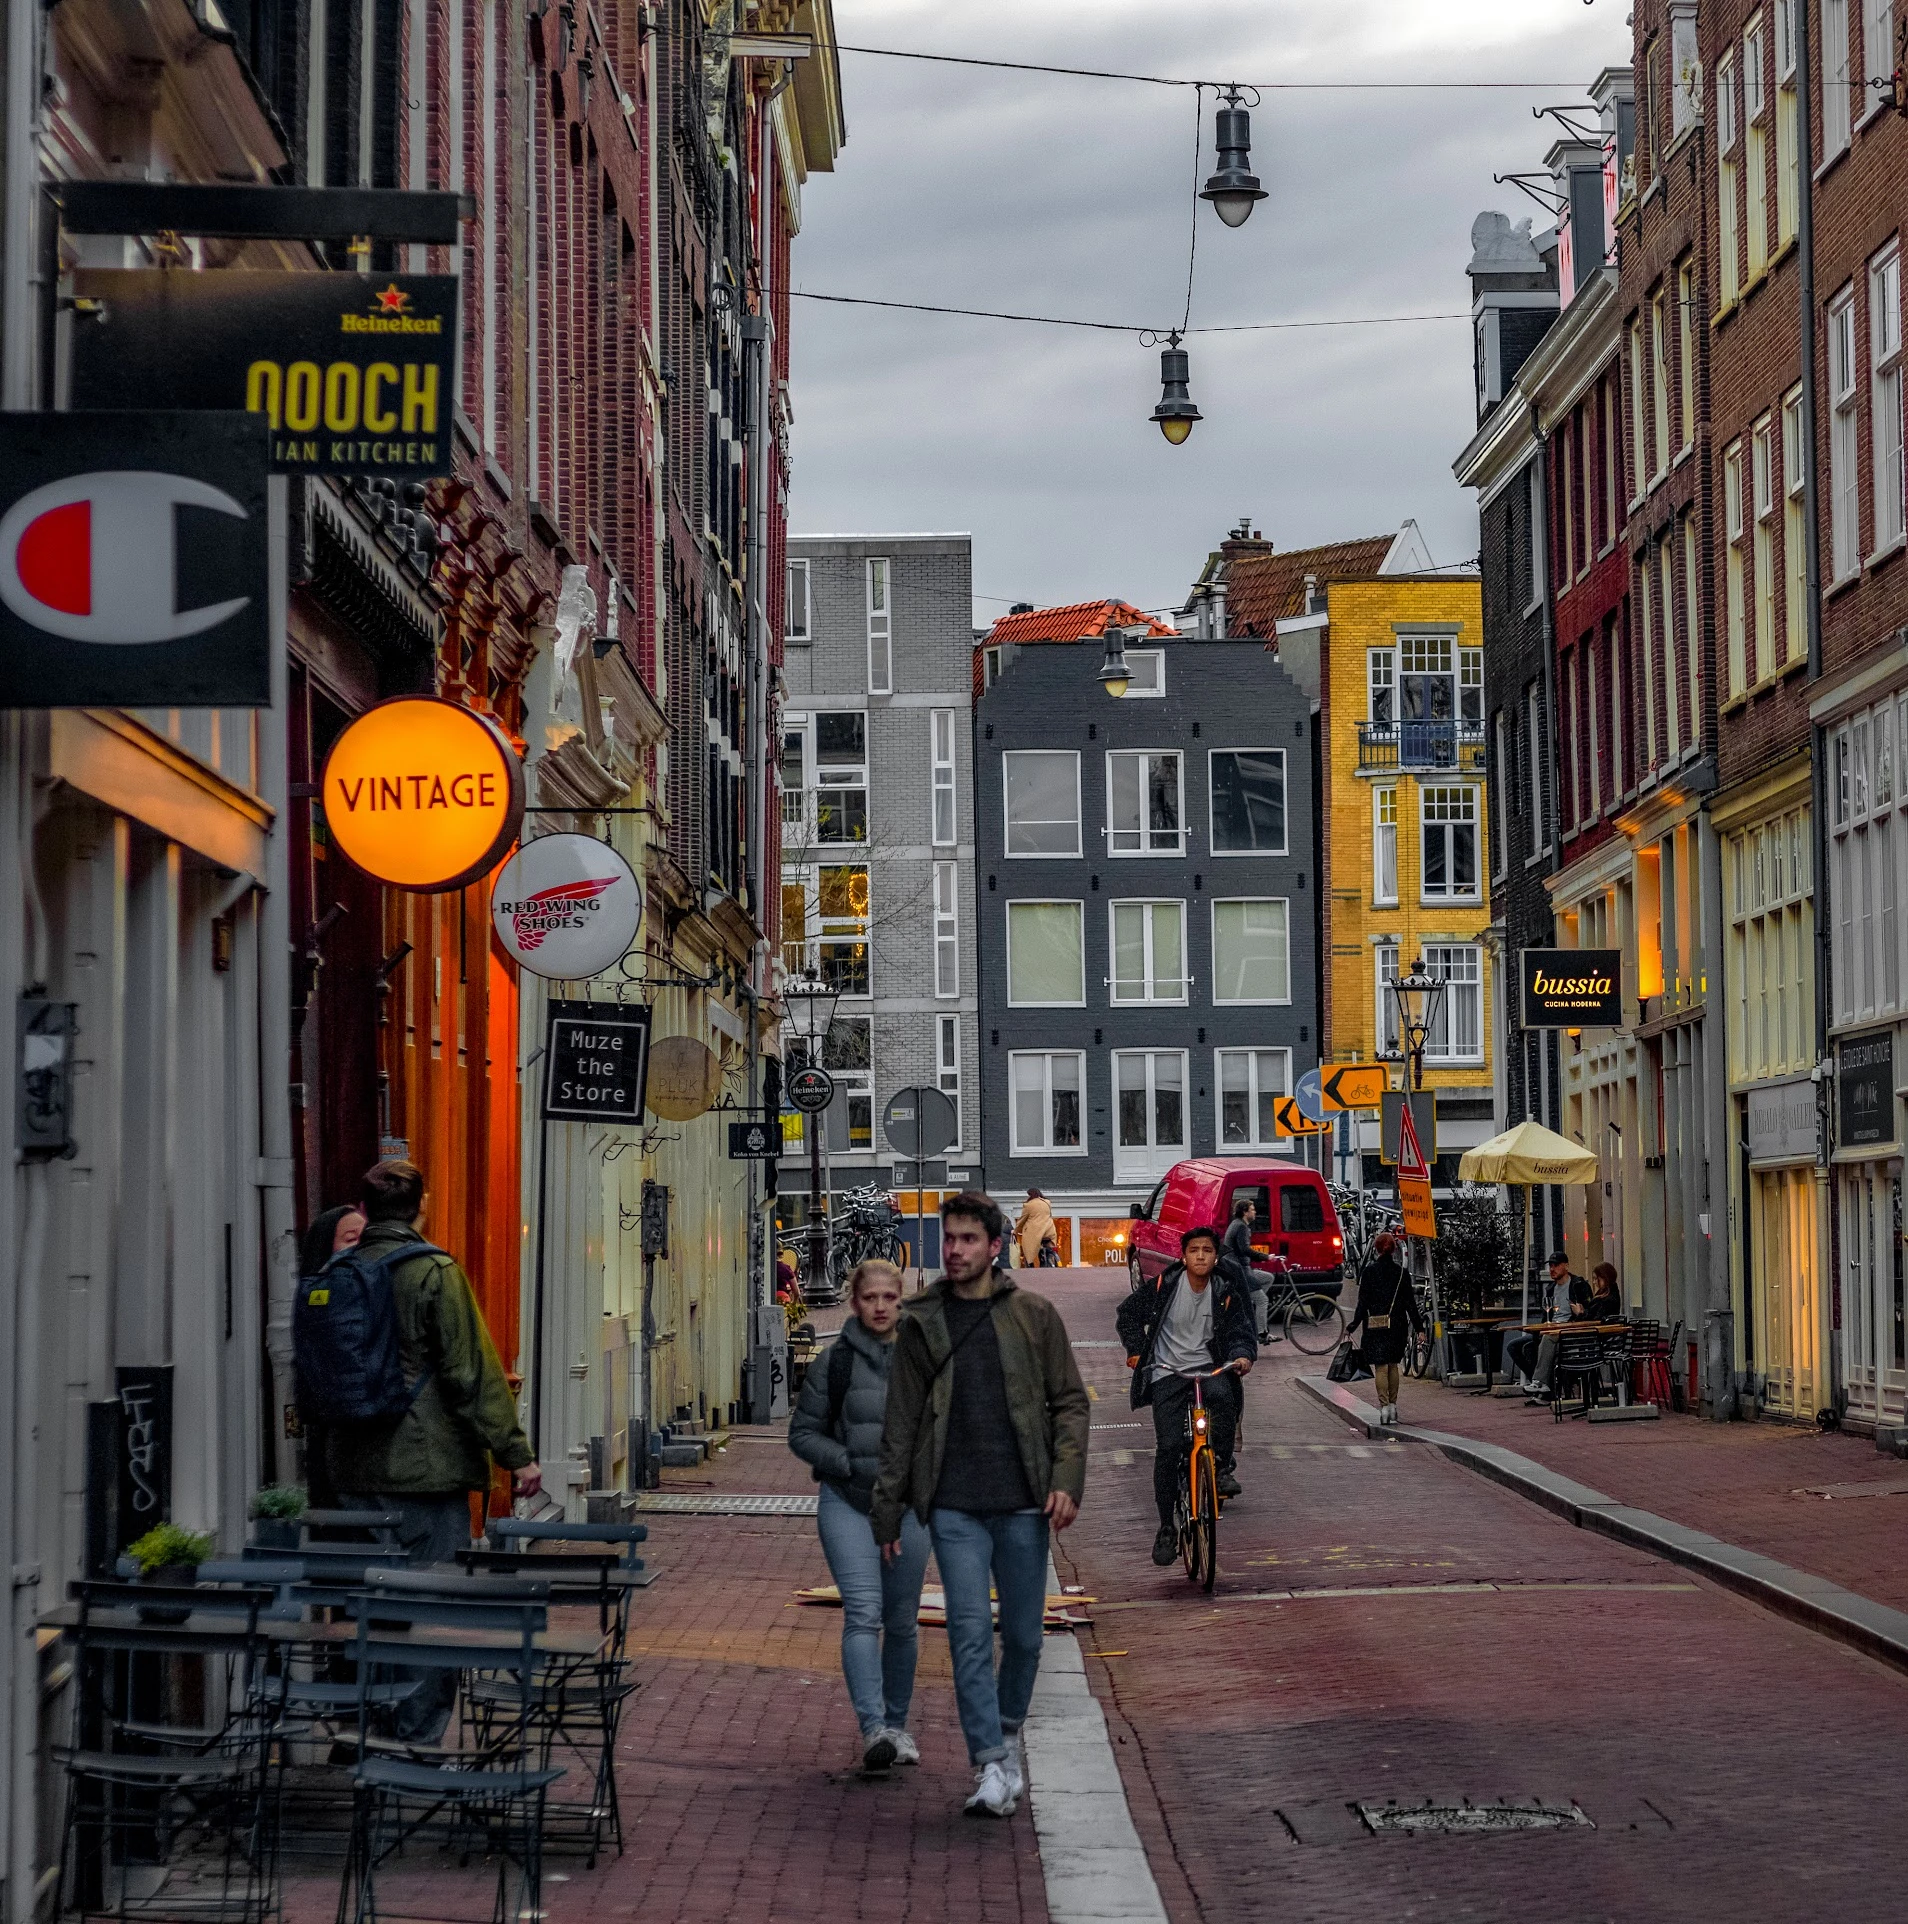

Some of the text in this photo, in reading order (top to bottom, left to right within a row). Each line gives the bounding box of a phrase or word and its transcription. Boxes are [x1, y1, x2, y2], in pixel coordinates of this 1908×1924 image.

[341, 314, 441, 334] Heineken
[275, 441, 437, 463] IAN KITCHEN
[337, 773, 495, 812] VINTAGE
[501, 899, 600, 914] RED WING
[519, 916, 585, 930] SHOES
[1533, 969, 1612, 995] bussia
[570, 1030, 624, 1051] Muze
[577, 1057, 615, 1076] the
[560, 1081, 626, 1103] Store
[658, 1077, 698, 1094] PLUK
[792, 1085, 829, 1095] Heineken
[1533, 1162, 1569, 1174] bussia
[1401, 1192, 1423, 1203] situatie
[1404, 1208, 1429, 1221] gewijzigd
